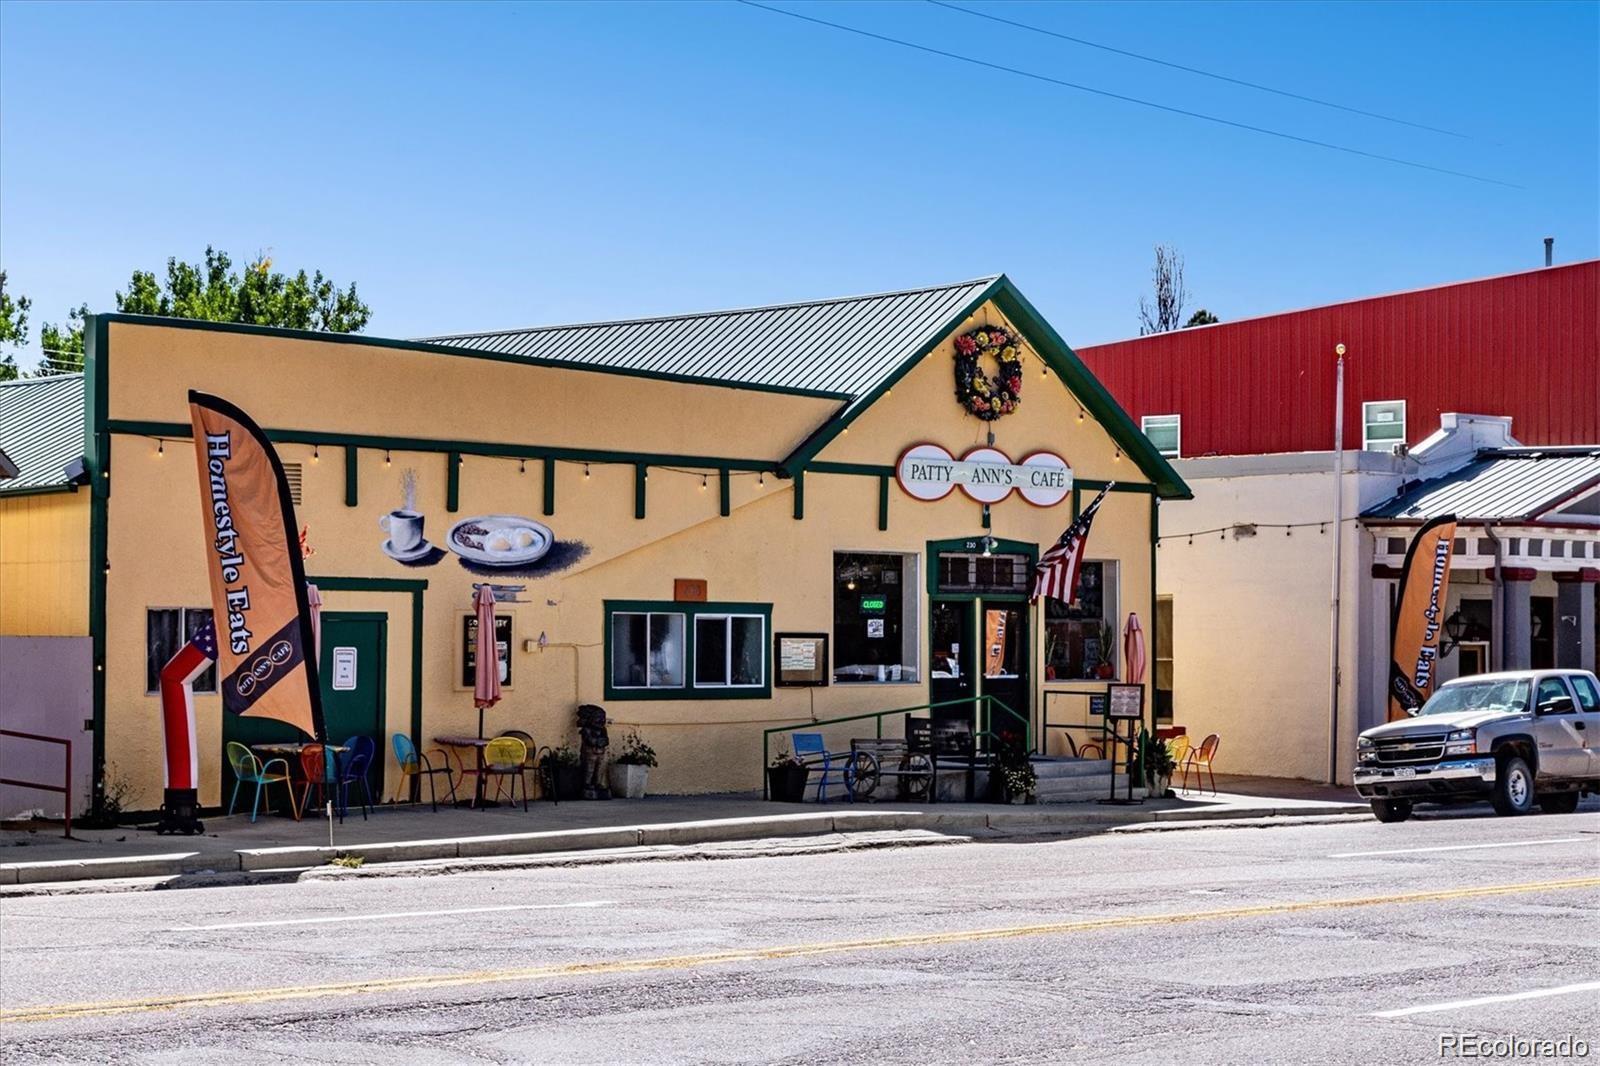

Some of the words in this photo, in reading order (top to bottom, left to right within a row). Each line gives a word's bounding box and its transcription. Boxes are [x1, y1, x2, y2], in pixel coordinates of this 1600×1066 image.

[911, 464, 953, 482] PATTY
[971, 468, 1012, 485] ANN'S
[1031, 468, 1065, 488] CAFÉ
[207, 431, 244, 584] Homestyle
[226, 587, 252, 654] Eats
[966, 541, 976, 549] 230
[863, 600, 884, 608] CLOSED
[1424, 538, 1450, 641] Homestyle
[1415, 644, 1437, 689] Eats
